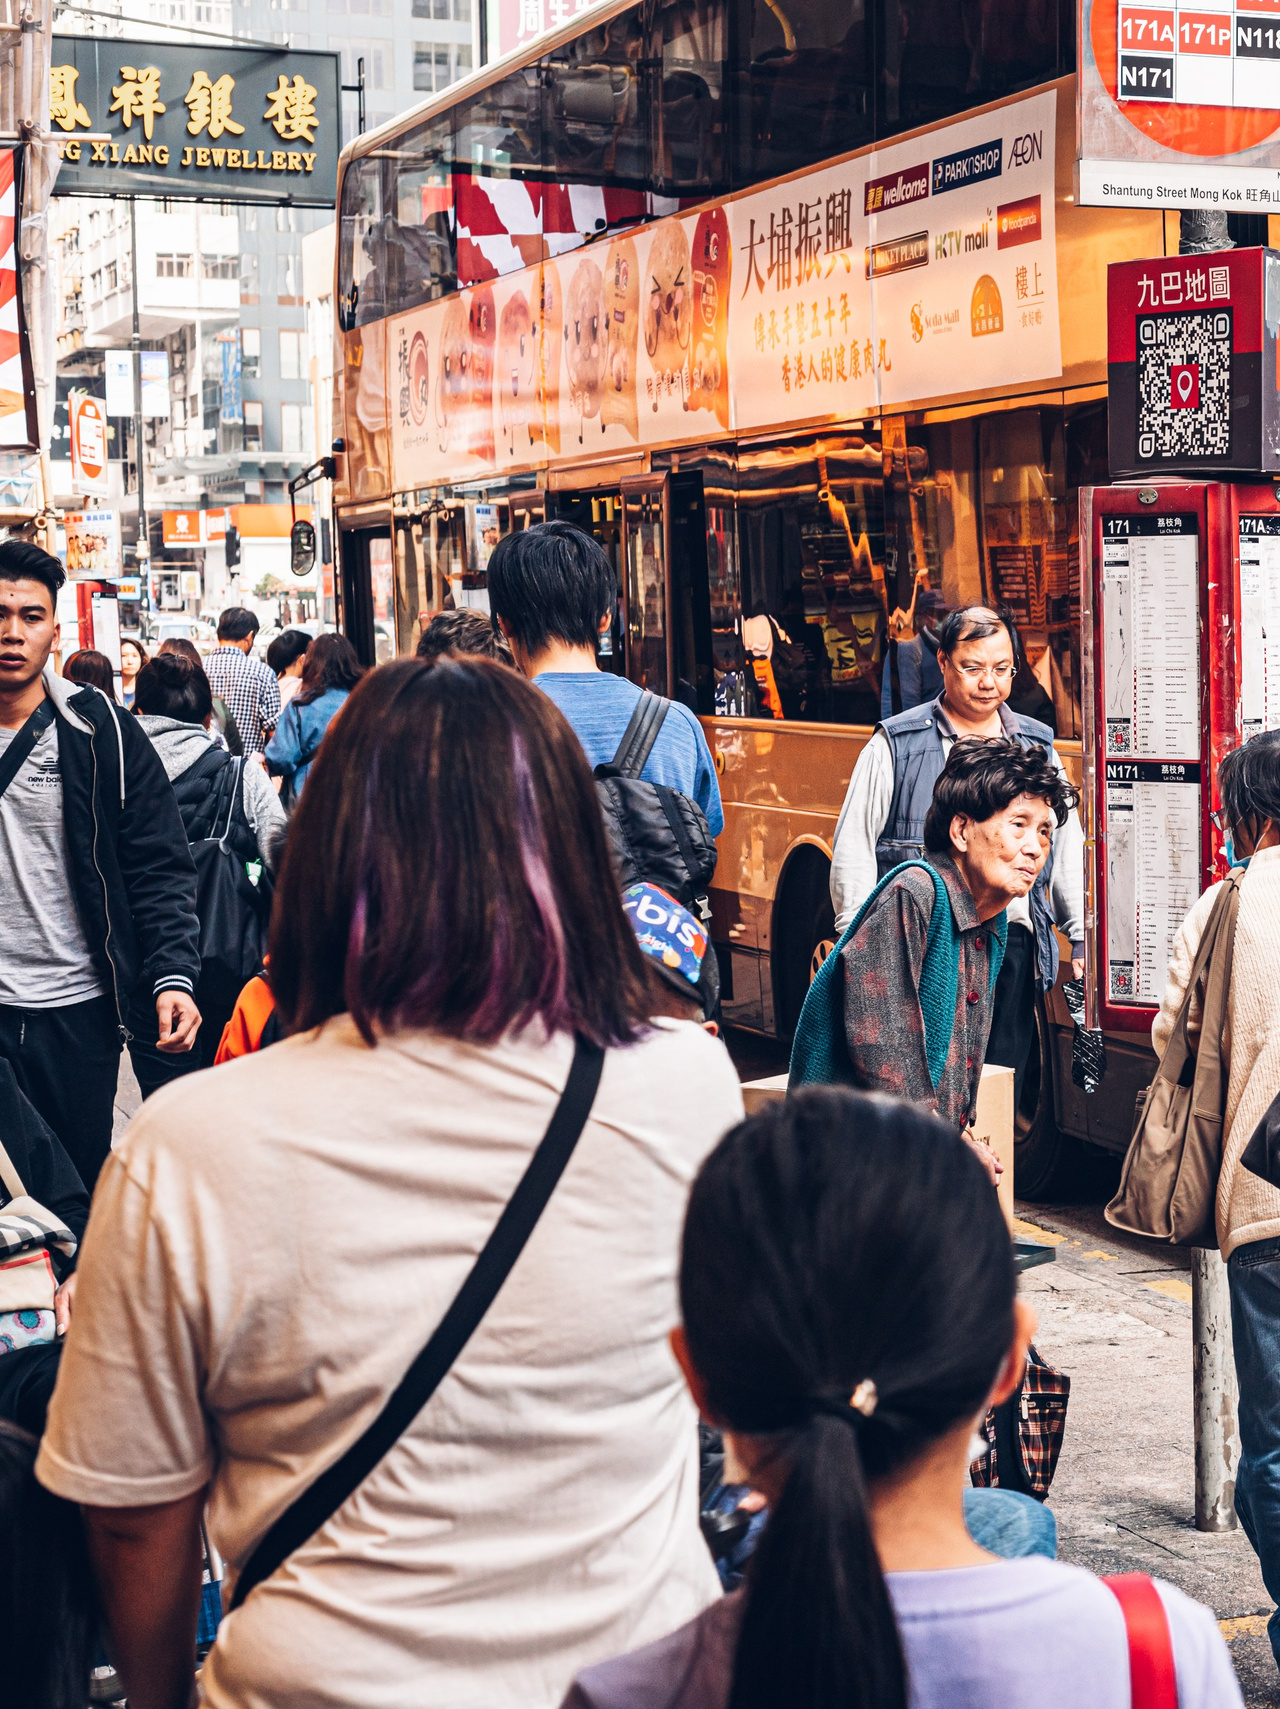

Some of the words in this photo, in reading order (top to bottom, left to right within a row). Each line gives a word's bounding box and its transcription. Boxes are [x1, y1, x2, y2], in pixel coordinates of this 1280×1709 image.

[1122, 18, 1174, 42] 171A
[1180, 22, 1231, 46] 171P
[1122, 66, 1172, 89] N171
[50, 64, 320, 144] 鳳祥銀樓
[91, 142, 170, 165] XIANG
[181, 146, 317, 172] JEWELLERY
[866, 185, 884, 211] 惠康
[883, 176, 928, 206] wellcome
[1102, 183, 1153, 200] Shantung
[1156, 185, 1188, 199] Street
[1190, 187, 1219, 202] Mong
[1222, 188, 1242, 201] Kok
[1008, 212, 1037, 231] foodpanda
[740, 188, 853, 301] 大埔振興
[935, 229, 962, 260] HKTV
[964, 222, 989, 253] mall
[1015, 262, 1044, 300] 樓上
[1137, 265, 1231, 308] 九巴地圖
[753, 292, 851, 353] 傳承手藝五十年
[782, 338, 892, 394] 香港人的健康肉丸
[1107, 519, 1130, 534] 171
[1157, 517, 1182, 528] 荔枝角
[1239, 518, 1266, 534] 171A
[1107, 764, 1138, 779] N171
[1161, 764, 1185, 775] 荔枝角
